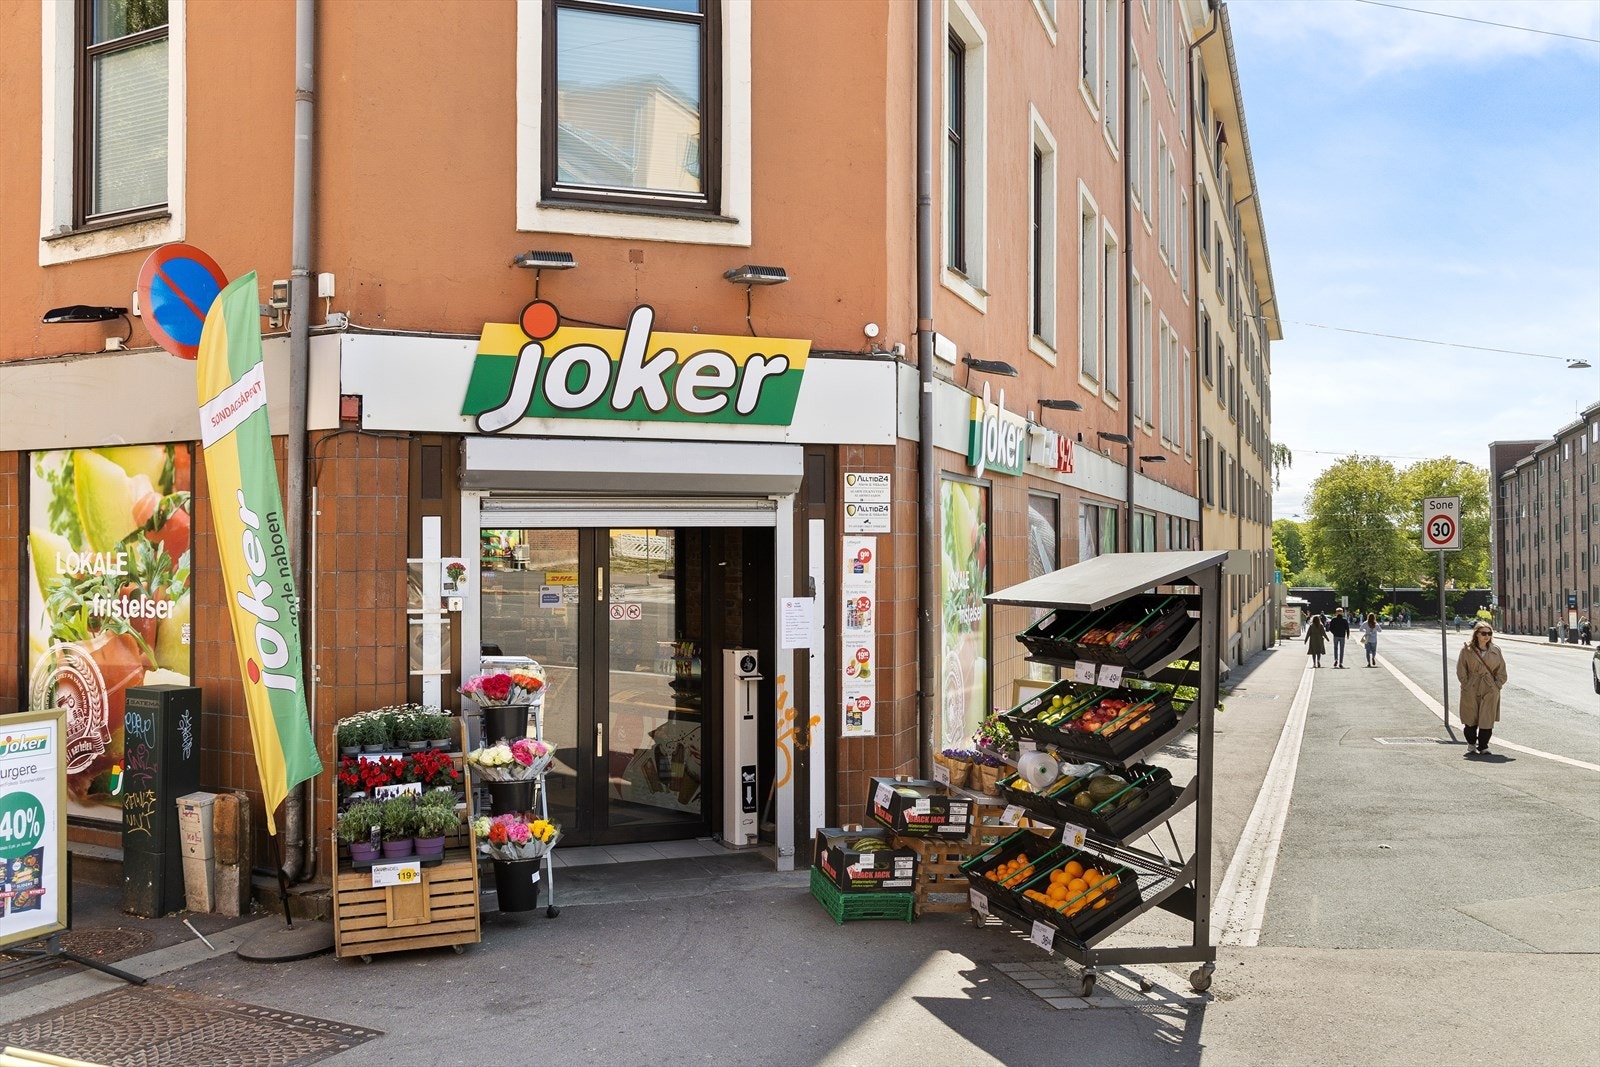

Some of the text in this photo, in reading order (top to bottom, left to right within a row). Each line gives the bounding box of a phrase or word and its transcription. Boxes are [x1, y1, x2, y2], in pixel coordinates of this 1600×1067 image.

[475, 299, 790, 436] joker
[976, 380, 1023, 480] joker
[1429, 501, 1454, 510] Sone
[1432, 522, 1450, 537] 30
[265, 511, 290, 578] naboen
[56, 551, 129, 576] LOKALE
[237, 488, 297, 695] joker
[92, 592, 176, 619] fristelser
[0, 734, 45, 758] joker
[397, 871, 412, 880] 119
